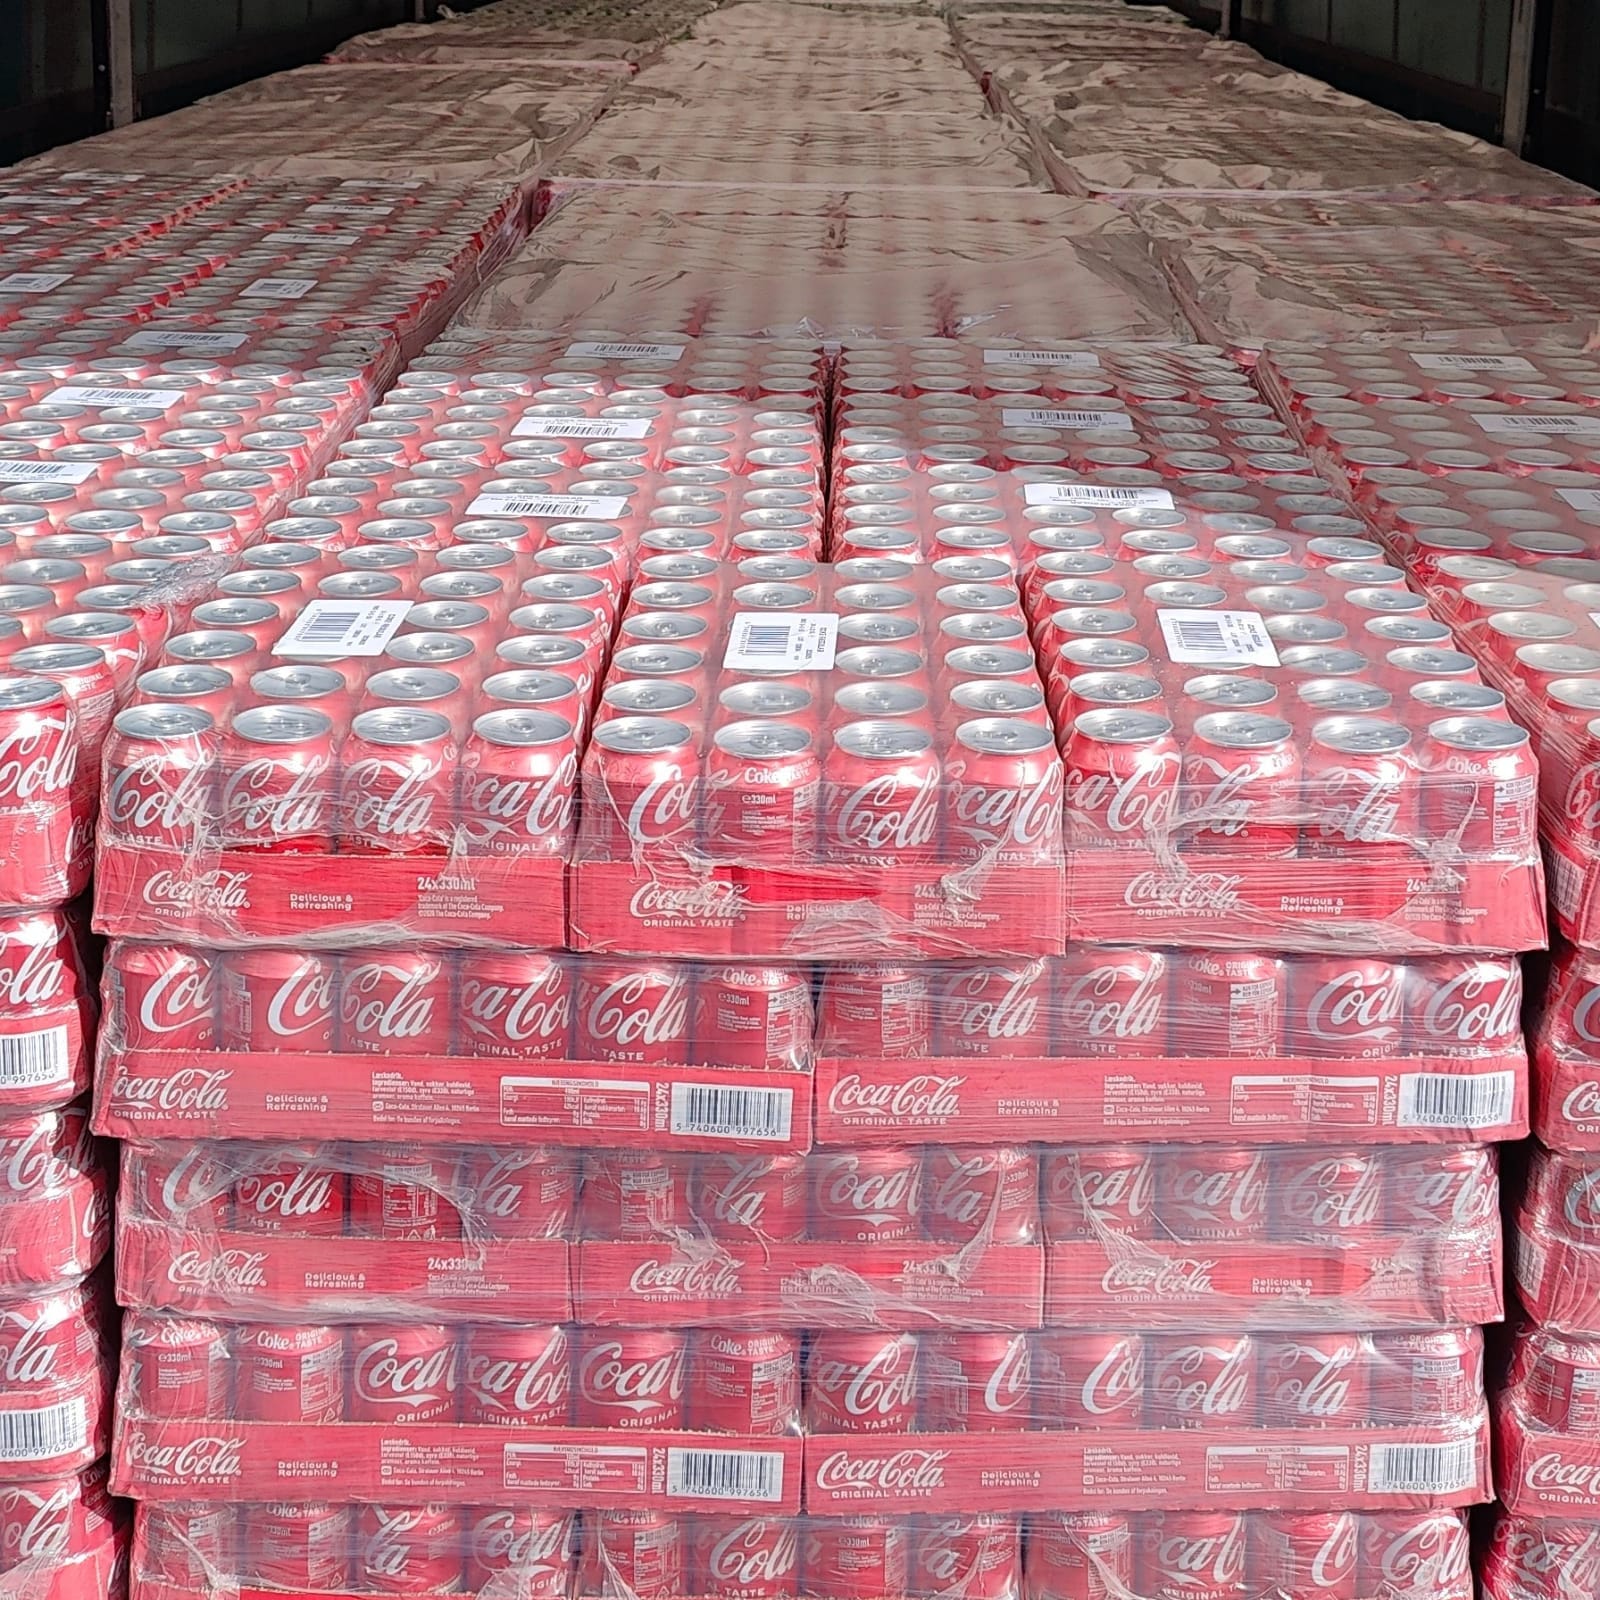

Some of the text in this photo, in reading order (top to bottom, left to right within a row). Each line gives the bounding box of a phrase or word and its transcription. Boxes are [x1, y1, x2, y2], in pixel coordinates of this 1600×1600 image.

[417, 876, 476, 891] 24x330ml
[290, 893, 354, 903] Delicious &
[1281, 896, 1344, 906] Delicious &
[290, 901, 352, 911] Refreshing
[1281, 903, 1342, 914] Refreshing
[643, 919, 734, 928] ORIGINAL TASTE
[722, 967, 755, 985] Coke
[602, 1048, 644, 1061] TASTE
[266, 1094, 329, 1103] Delicious &
[829, 1075, 967, 1116] Coca-Cola
[1383, 1075, 1398, 1126] 24x330ml
[266, 1102, 328, 1112] Refreshing
[655, 1082, 669, 1132] 24x330ml
[998, 1099, 1060, 1108] Delicious &
[177, 1110, 217, 1120] TASTE
[998, 1107, 1060, 1117] Refreshing
[843, 1116, 947, 1126] ORIGINAL TASTE
[1415, 1114, 1457, 1125] 740600
[676, 1122, 778, 1137] 5 740600 997656
[305, 1272, 366, 1281] Delicious &
[305, 1279, 365, 1289] Refreshing
[1252, 1278, 1313, 1287] Delicious &
[643, 1292, 693, 1302] ORIGINAL
[257, 1330, 290, 1350] Coke
[711, 1334, 743, 1355] Coke
[620, 1406, 679, 1428] ORIGINAL
[864, 1413, 903, 1429] TASTE
[278, 1460, 339, 1469] Delicious &
[817, 1449, 951, 1489] Coca-Cola
[1353, 1445, 1368, 1492] 24x330ml
[278, 1468, 338, 1478] Refreshing
[652, 1447, 665, 1494] 24x330ml
[981, 1470, 1041, 1479] Delicious &
[191, 1475, 230, 1485] TASTE
[981, 1478, 1040, 1488] Refreshing
[1373, 1481, 1379, 1490] 5
[1385, 1481, 1425, 1491] 740600
[671, 1485, 769, 1498] 5 740600 997656
[832, 1488, 932, 1499] ORIGINAL TASTE
[1539, 1493, 1599, 1505] ORIGINAL
